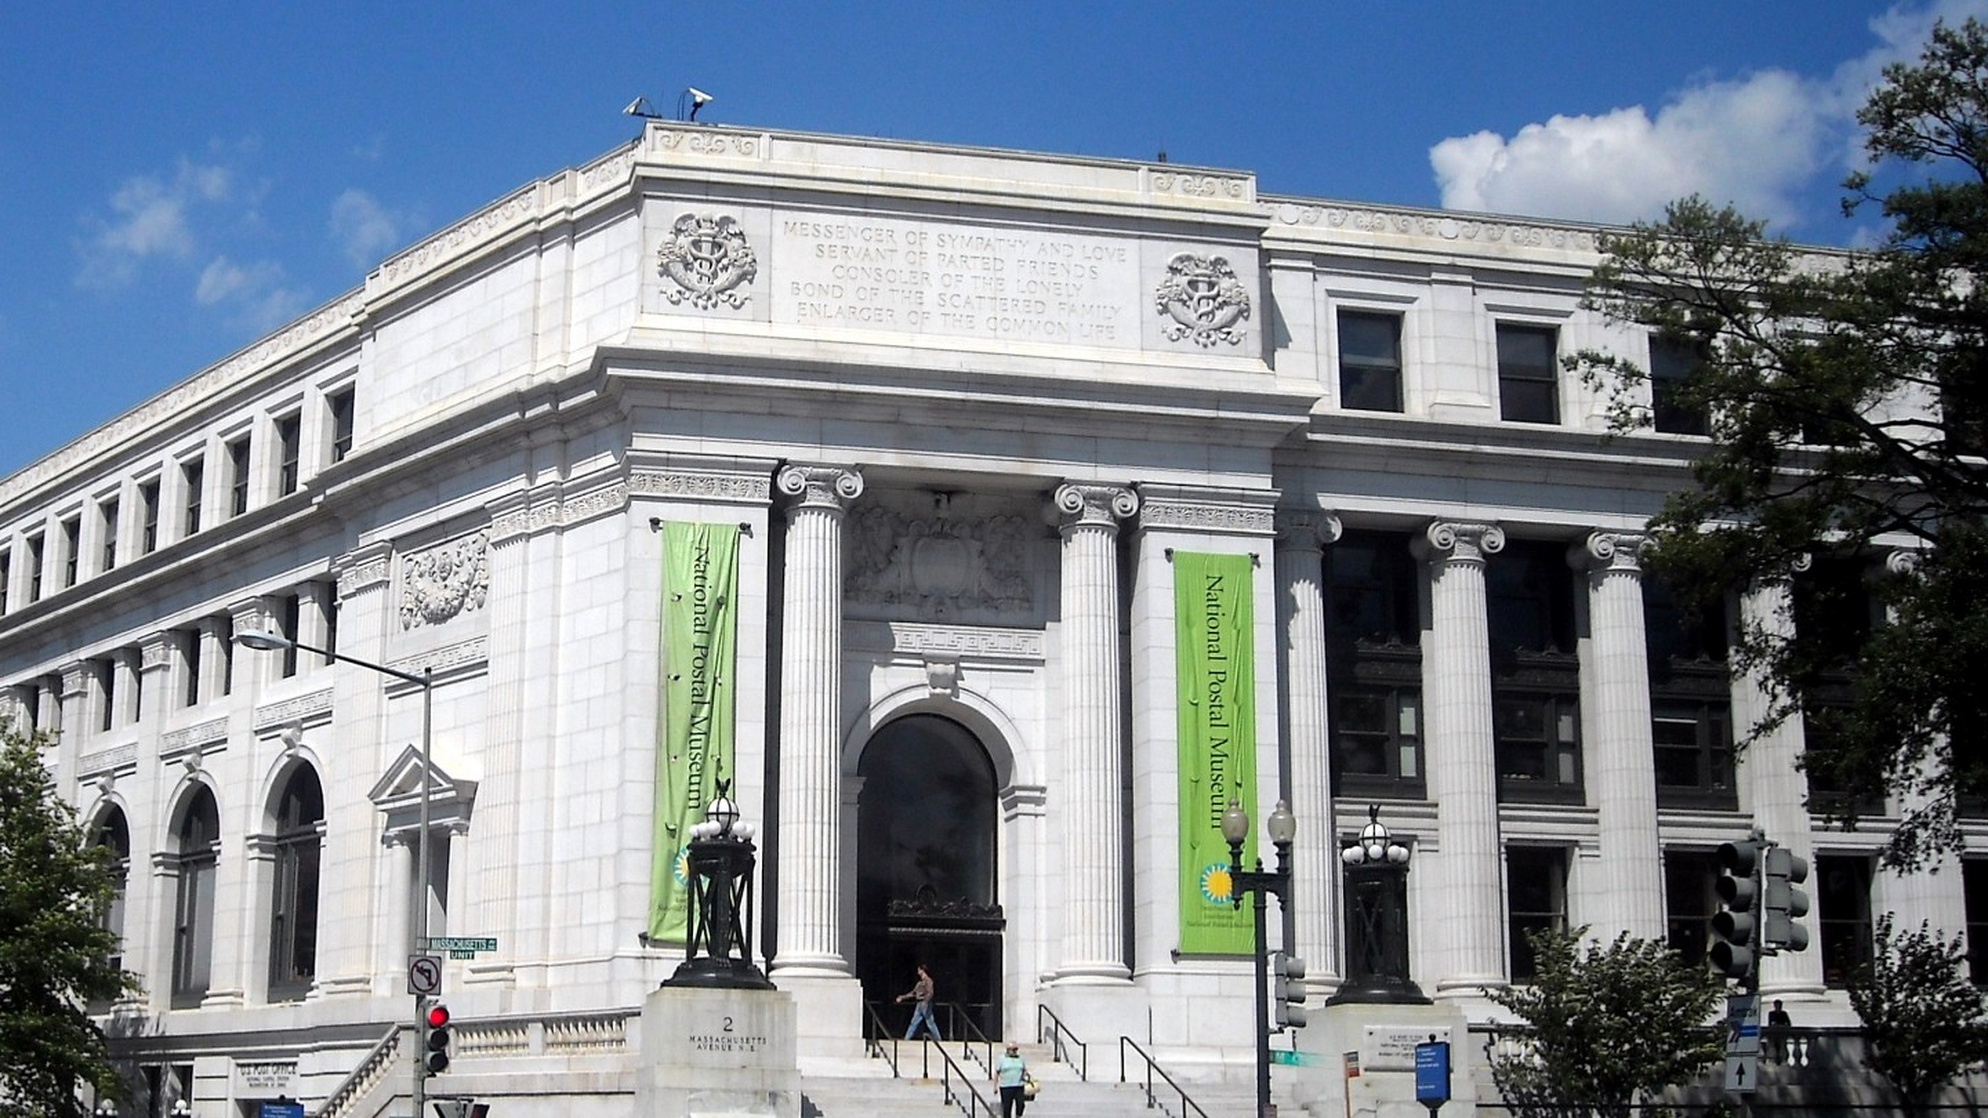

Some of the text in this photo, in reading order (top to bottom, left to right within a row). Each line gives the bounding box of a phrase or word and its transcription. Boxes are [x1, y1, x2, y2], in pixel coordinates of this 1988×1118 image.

[784, 220, 1126, 263] MESSENGER OF SYMPATHY AND LOVE
[815, 243, 1098, 280] SERVANT OF PARTED FRIENDS
[832, 264, 1083, 297] CONSOLER OF THE LONELY
[791, 281, 1122, 320] BOND OF THE SCATTERED FAMILY
[798, 302, 1116, 339] ENLARGER OF THE COMMON LIFE
[687, 546, 711, 809] National Postal Museum
[1205, 575, 1230, 829] National Postal Museum
[431, 939, 487, 950] MASSACHUSETTS
[451, 951, 474, 959] UNIT
[689, 1035, 767, 1045] MASSACHUSETTS
[723, 1016, 733, 1032] 2
[697, 1043, 732, 1052] AVENUE
